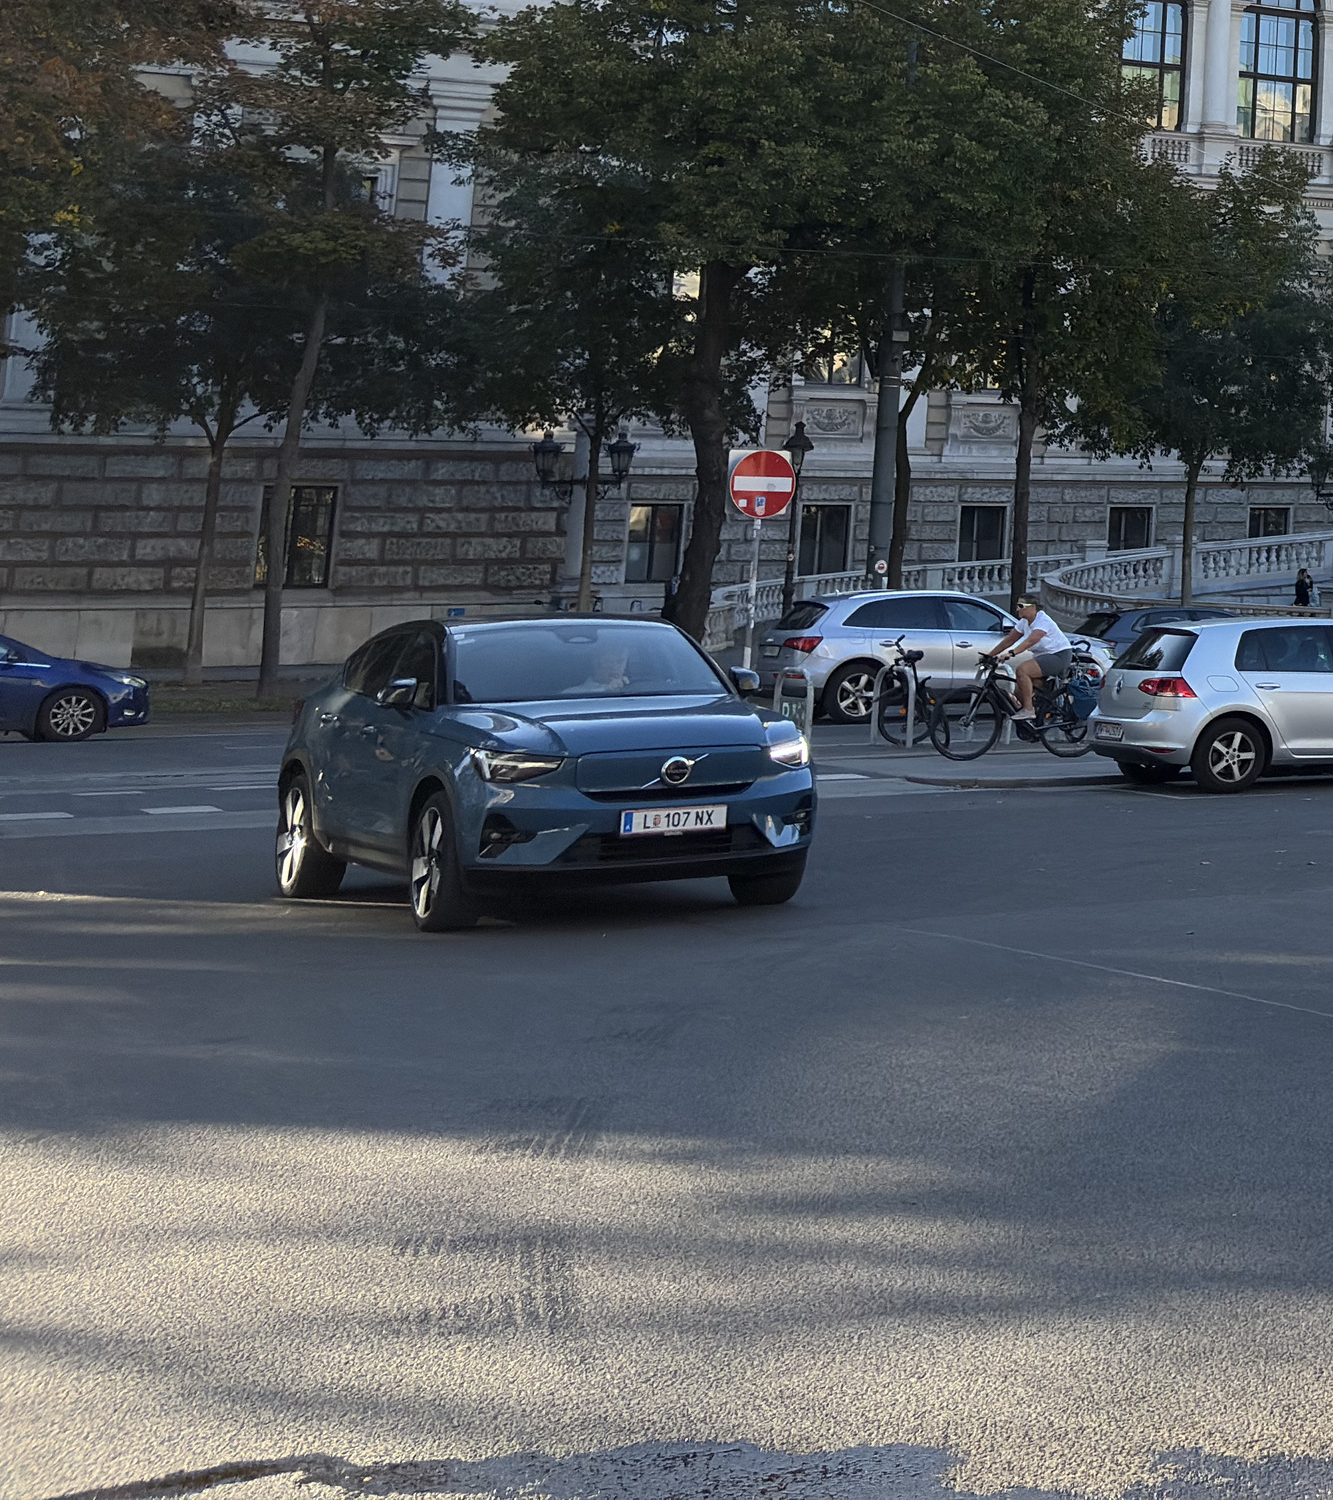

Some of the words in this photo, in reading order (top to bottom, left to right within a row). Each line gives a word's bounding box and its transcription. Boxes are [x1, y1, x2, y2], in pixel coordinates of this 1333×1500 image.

[643, 818, 650, 830] L
[665, 812, 690, 827] 107
[695, 810, 714, 826] NX
